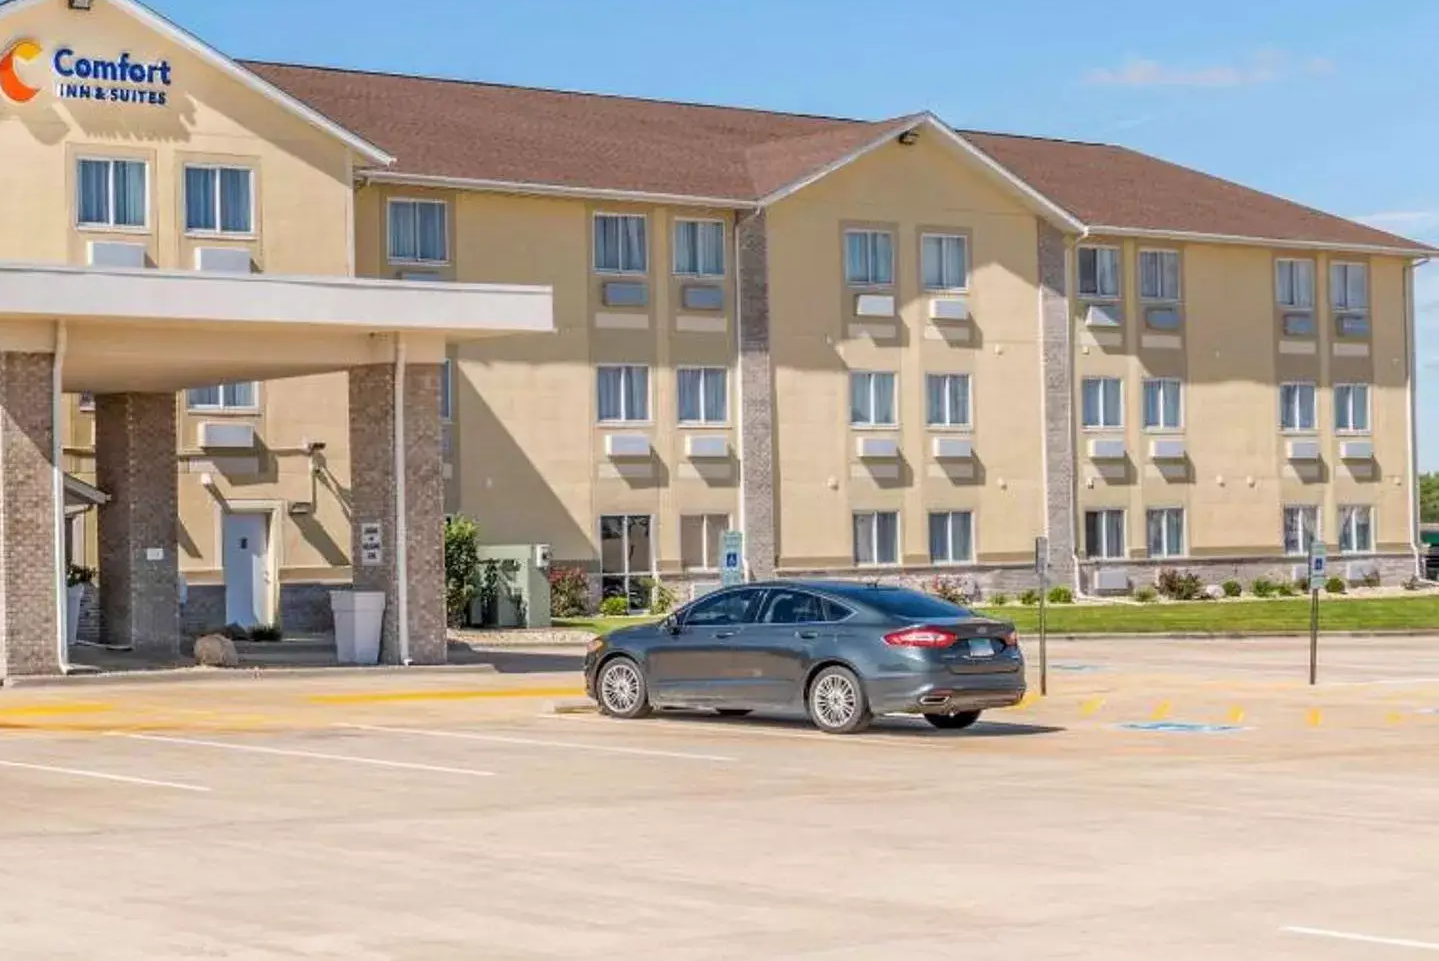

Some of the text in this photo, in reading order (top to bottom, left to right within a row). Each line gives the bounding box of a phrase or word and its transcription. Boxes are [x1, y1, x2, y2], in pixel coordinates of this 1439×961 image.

[54, 48, 171, 86] Comfort
[60, 83, 166, 105] INN & SUITES
